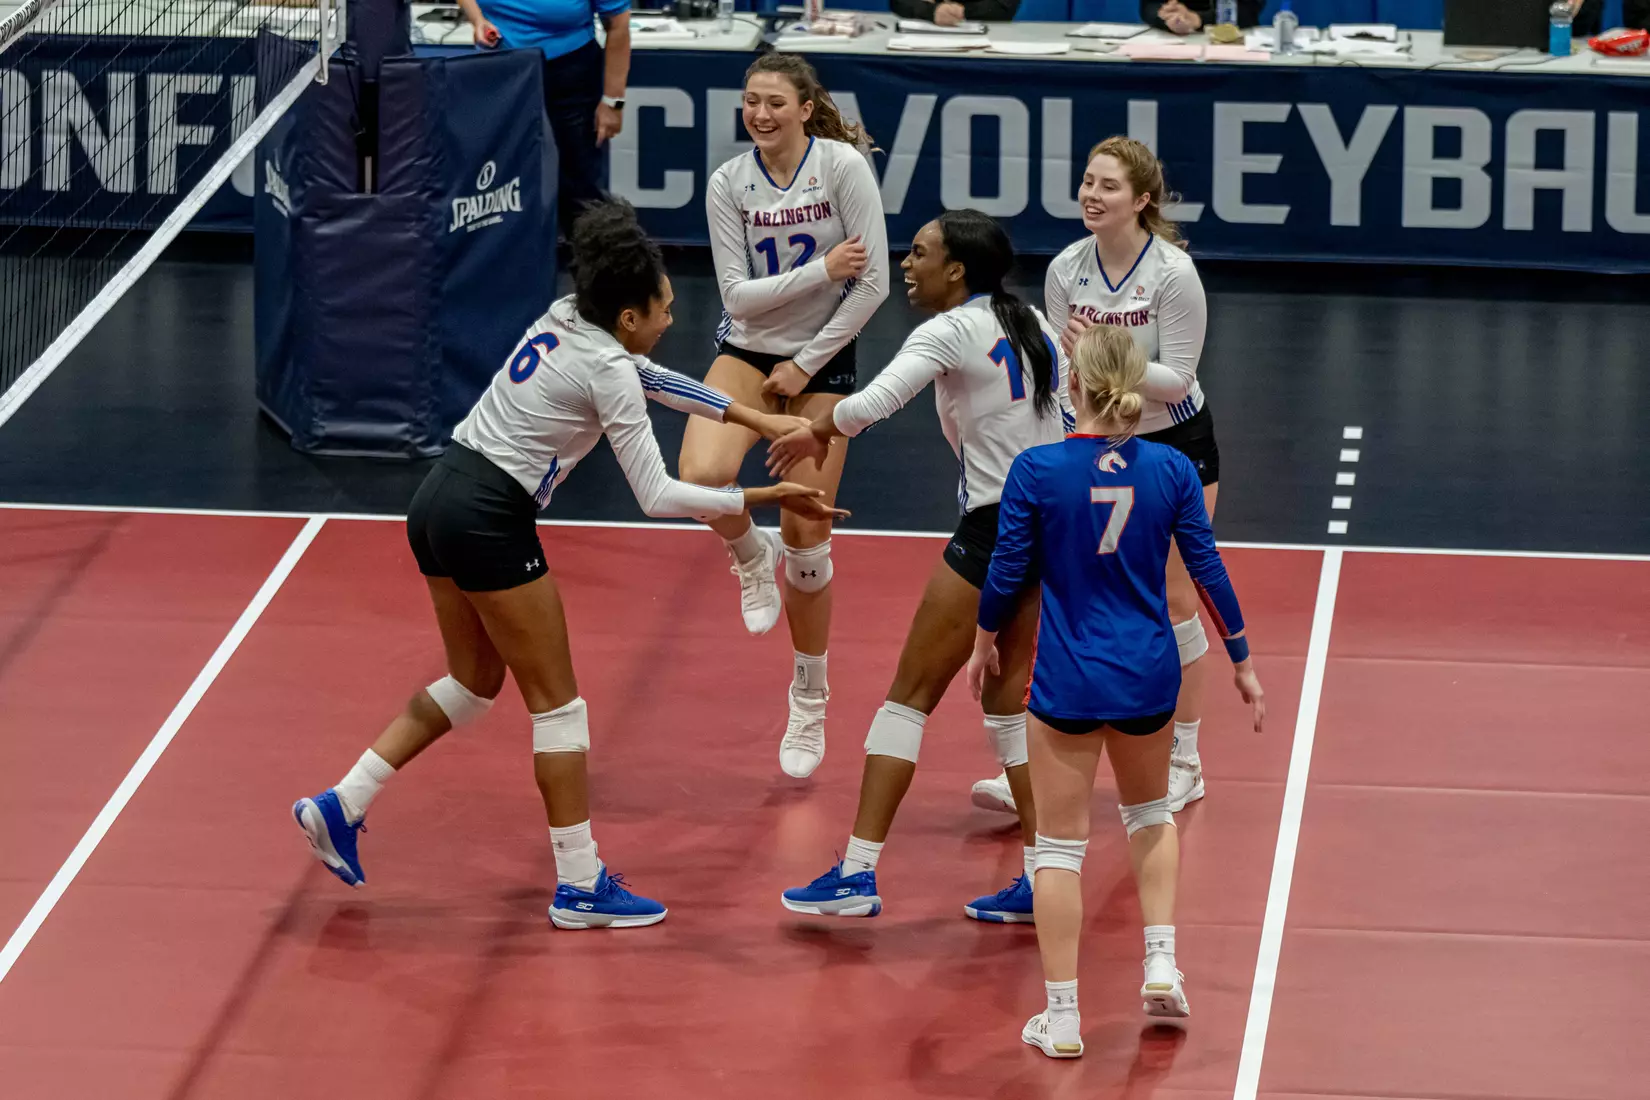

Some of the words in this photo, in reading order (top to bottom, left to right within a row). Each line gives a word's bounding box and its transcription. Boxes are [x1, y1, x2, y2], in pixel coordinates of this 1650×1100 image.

[449, 176, 523, 233] SPALDING
[753, 200, 832, 227] ARLINGTON
[754, 232, 817, 276] 12
[508, 331, 561, 385] 6
[1089, 486, 1134, 555] 7
